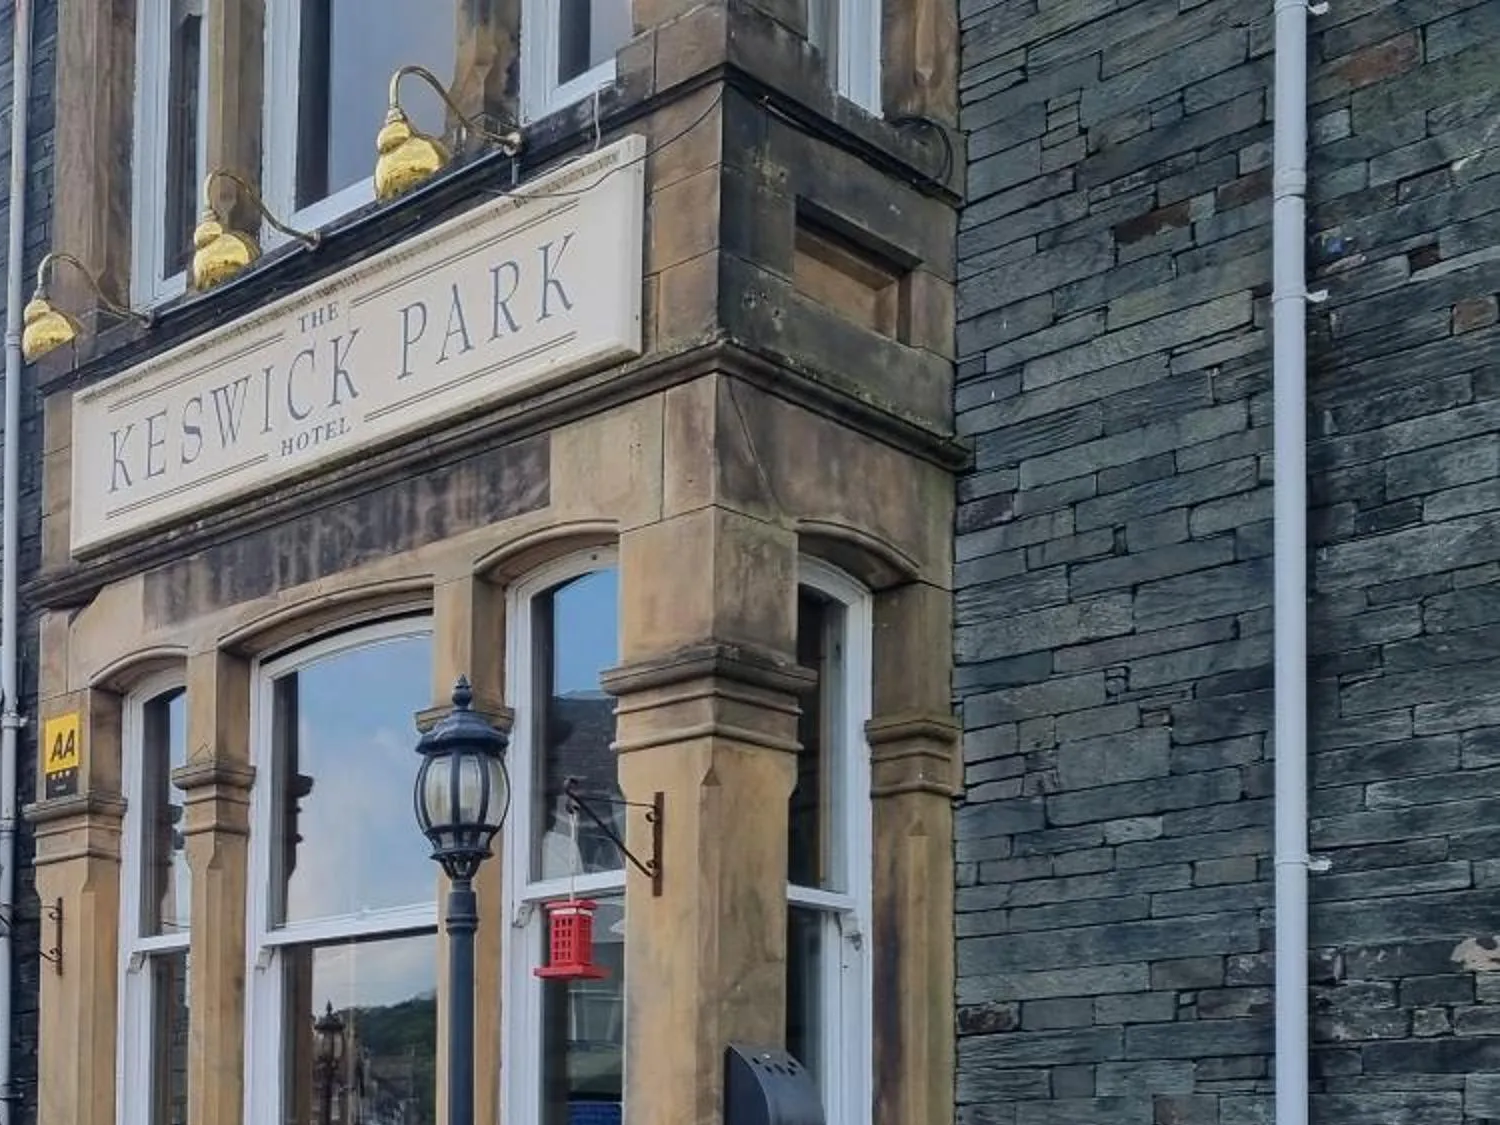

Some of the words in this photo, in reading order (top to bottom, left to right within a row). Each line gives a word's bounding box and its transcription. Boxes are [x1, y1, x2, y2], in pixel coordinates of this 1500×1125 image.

[298, 301, 340, 334] THE
[107, 327, 361, 493] KESWICK
[396, 232, 578, 381] PARK
[279, 416, 352, 458] HOTEL
[49, 727, 76, 764] AA
